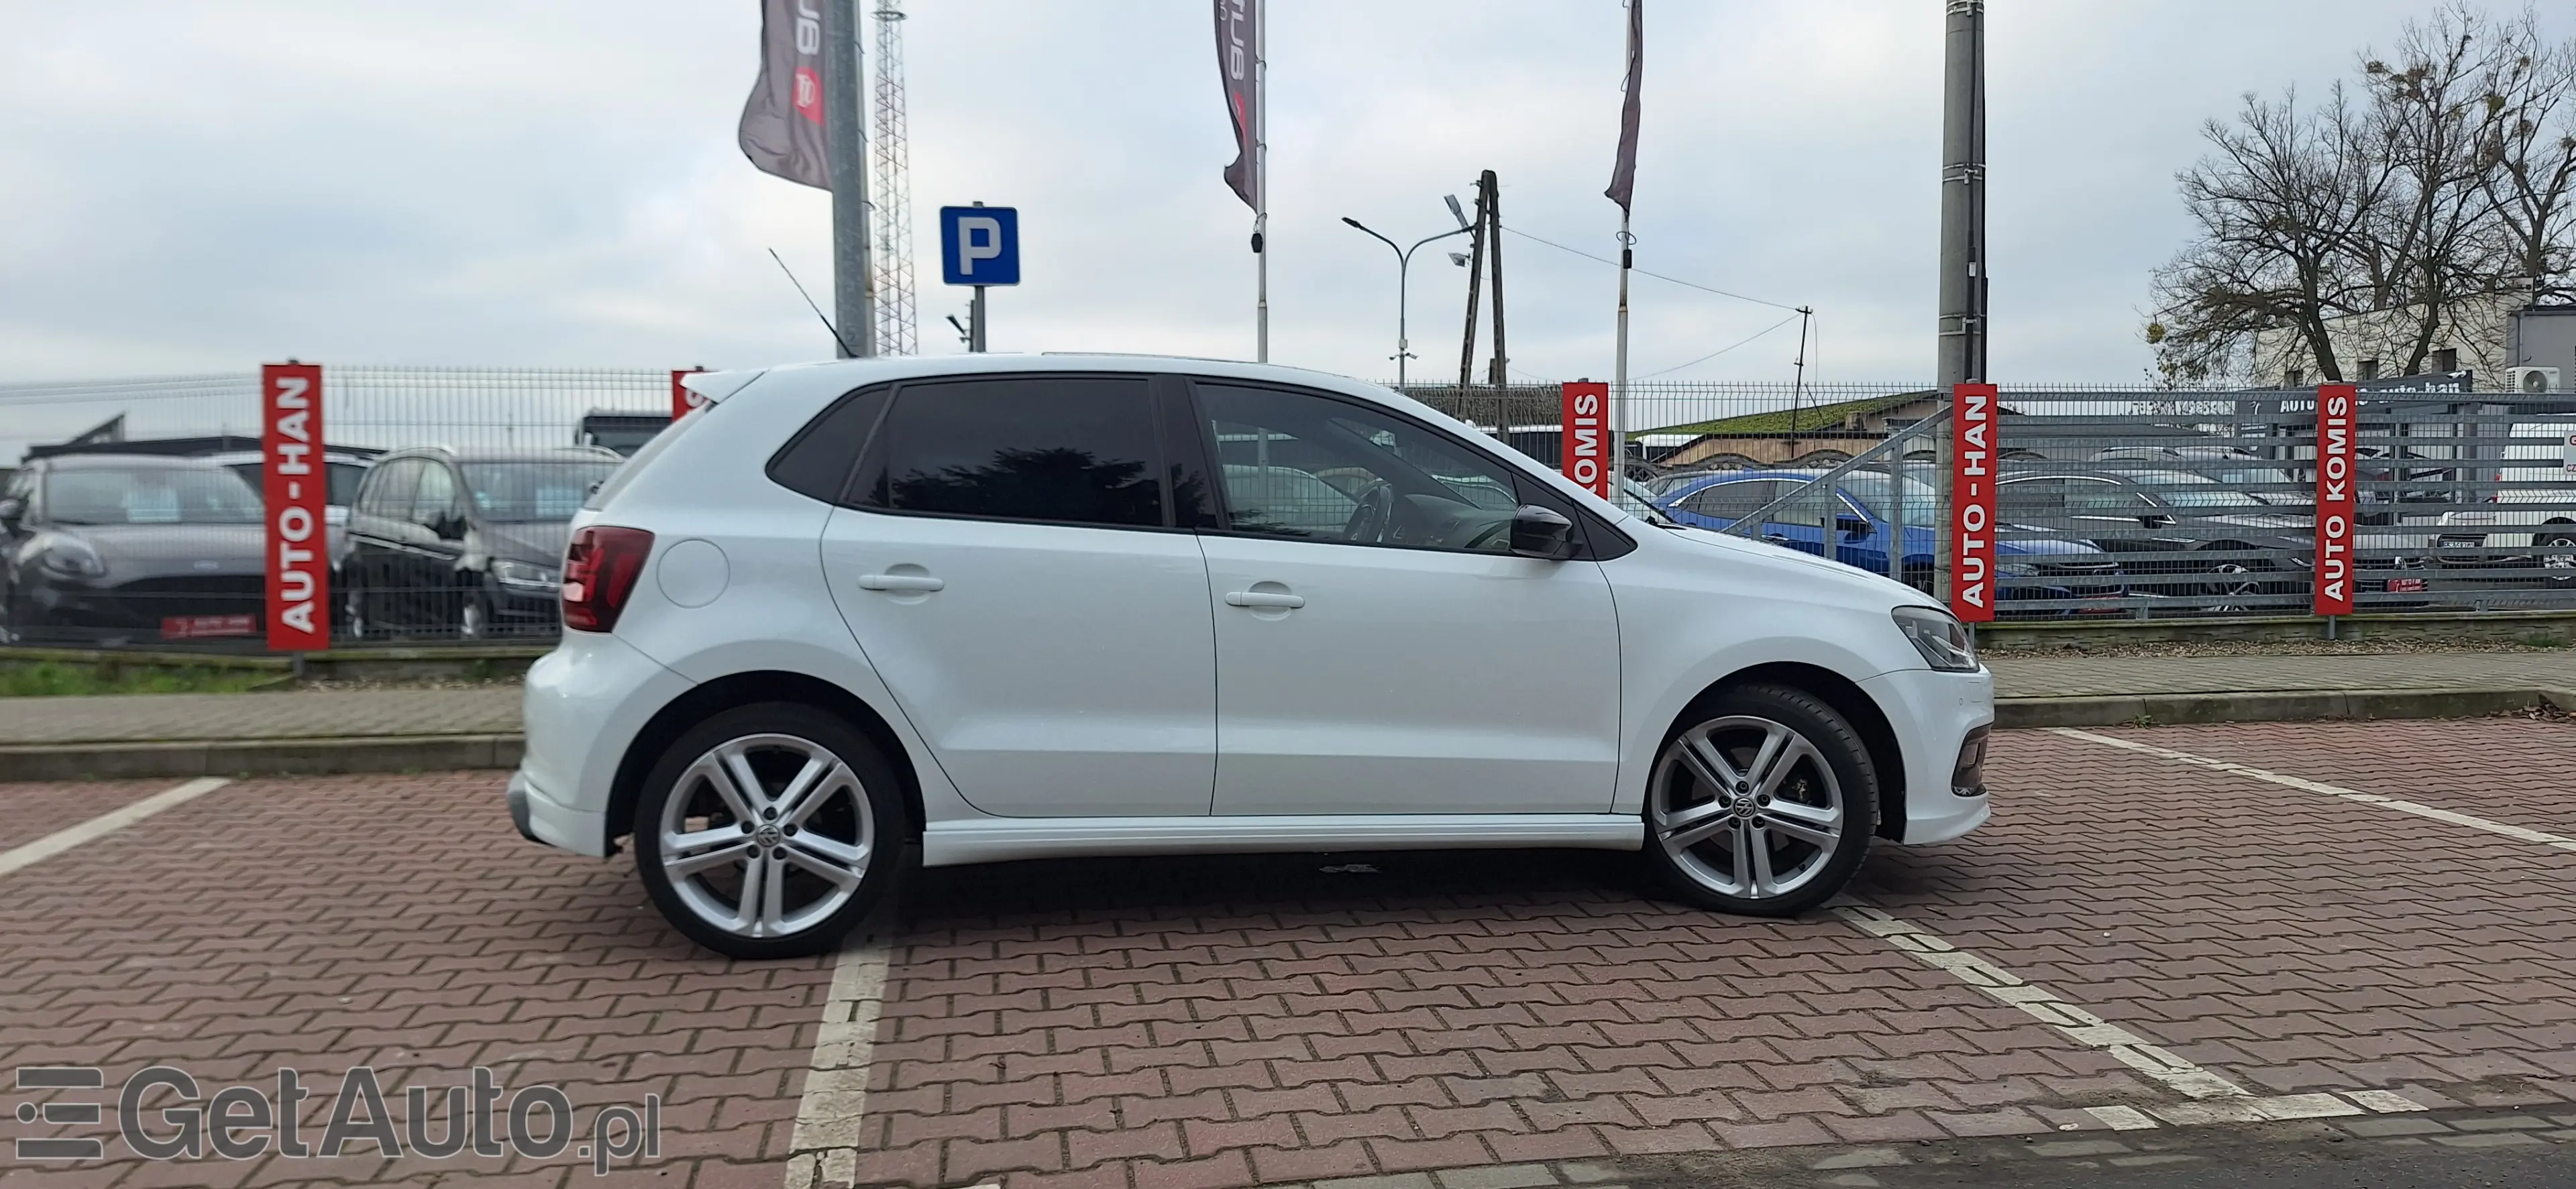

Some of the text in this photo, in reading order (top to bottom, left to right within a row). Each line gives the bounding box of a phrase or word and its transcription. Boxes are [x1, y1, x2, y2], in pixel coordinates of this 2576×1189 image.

[958, 216, 1002, 275] P
[1574, 394, 1597, 493] OMIS
[2324, 396, 2347, 602] AUTO KOMIS
